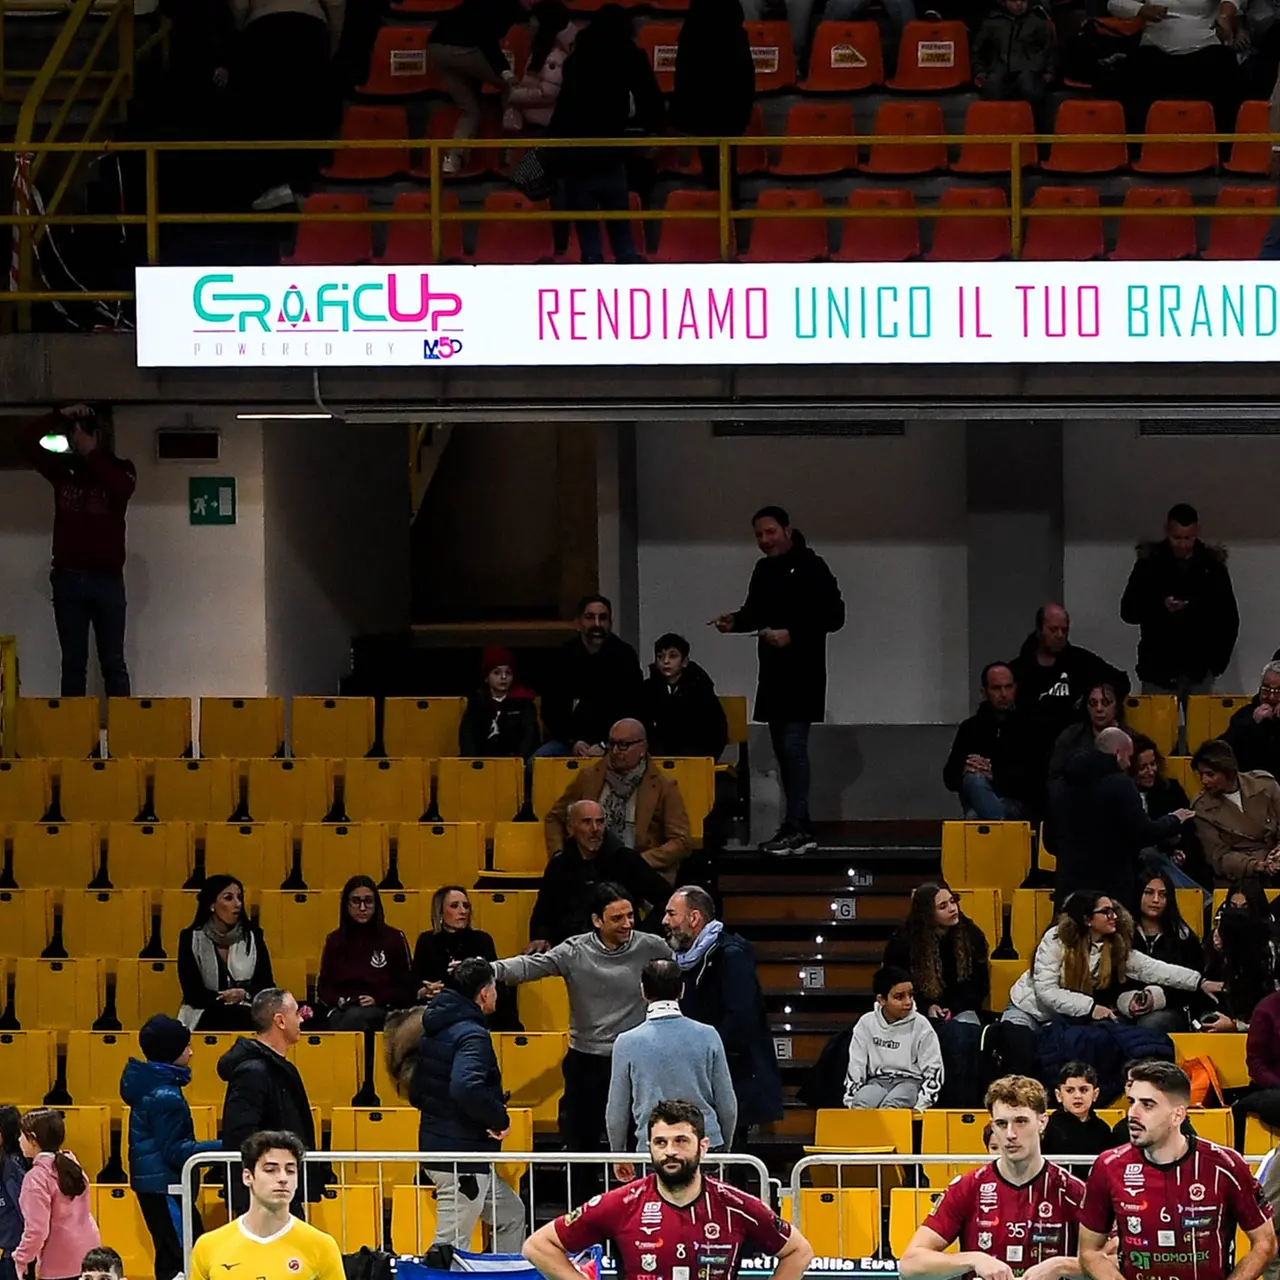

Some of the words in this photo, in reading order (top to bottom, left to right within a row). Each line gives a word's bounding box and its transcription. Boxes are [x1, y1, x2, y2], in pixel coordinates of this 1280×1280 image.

[538, 287, 767, 340] RENDIAMO
[795, 286, 931, 339] UNICO
[959, 287, 991, 338] IL
[1016, 285, 1100, 337] TUO
[1128, 284, 1277, 337] BRAND
[194, 342, 333, 356] POWERED
[366, 342, 396, 356] BY
[1159, 1206, 1171, 1223] 6
[1005, 1222, 1027, 1238] 35
[676, 1243, 686, 1259] 8
[1153, 1251, 1210, 1263] DOMOTEK
